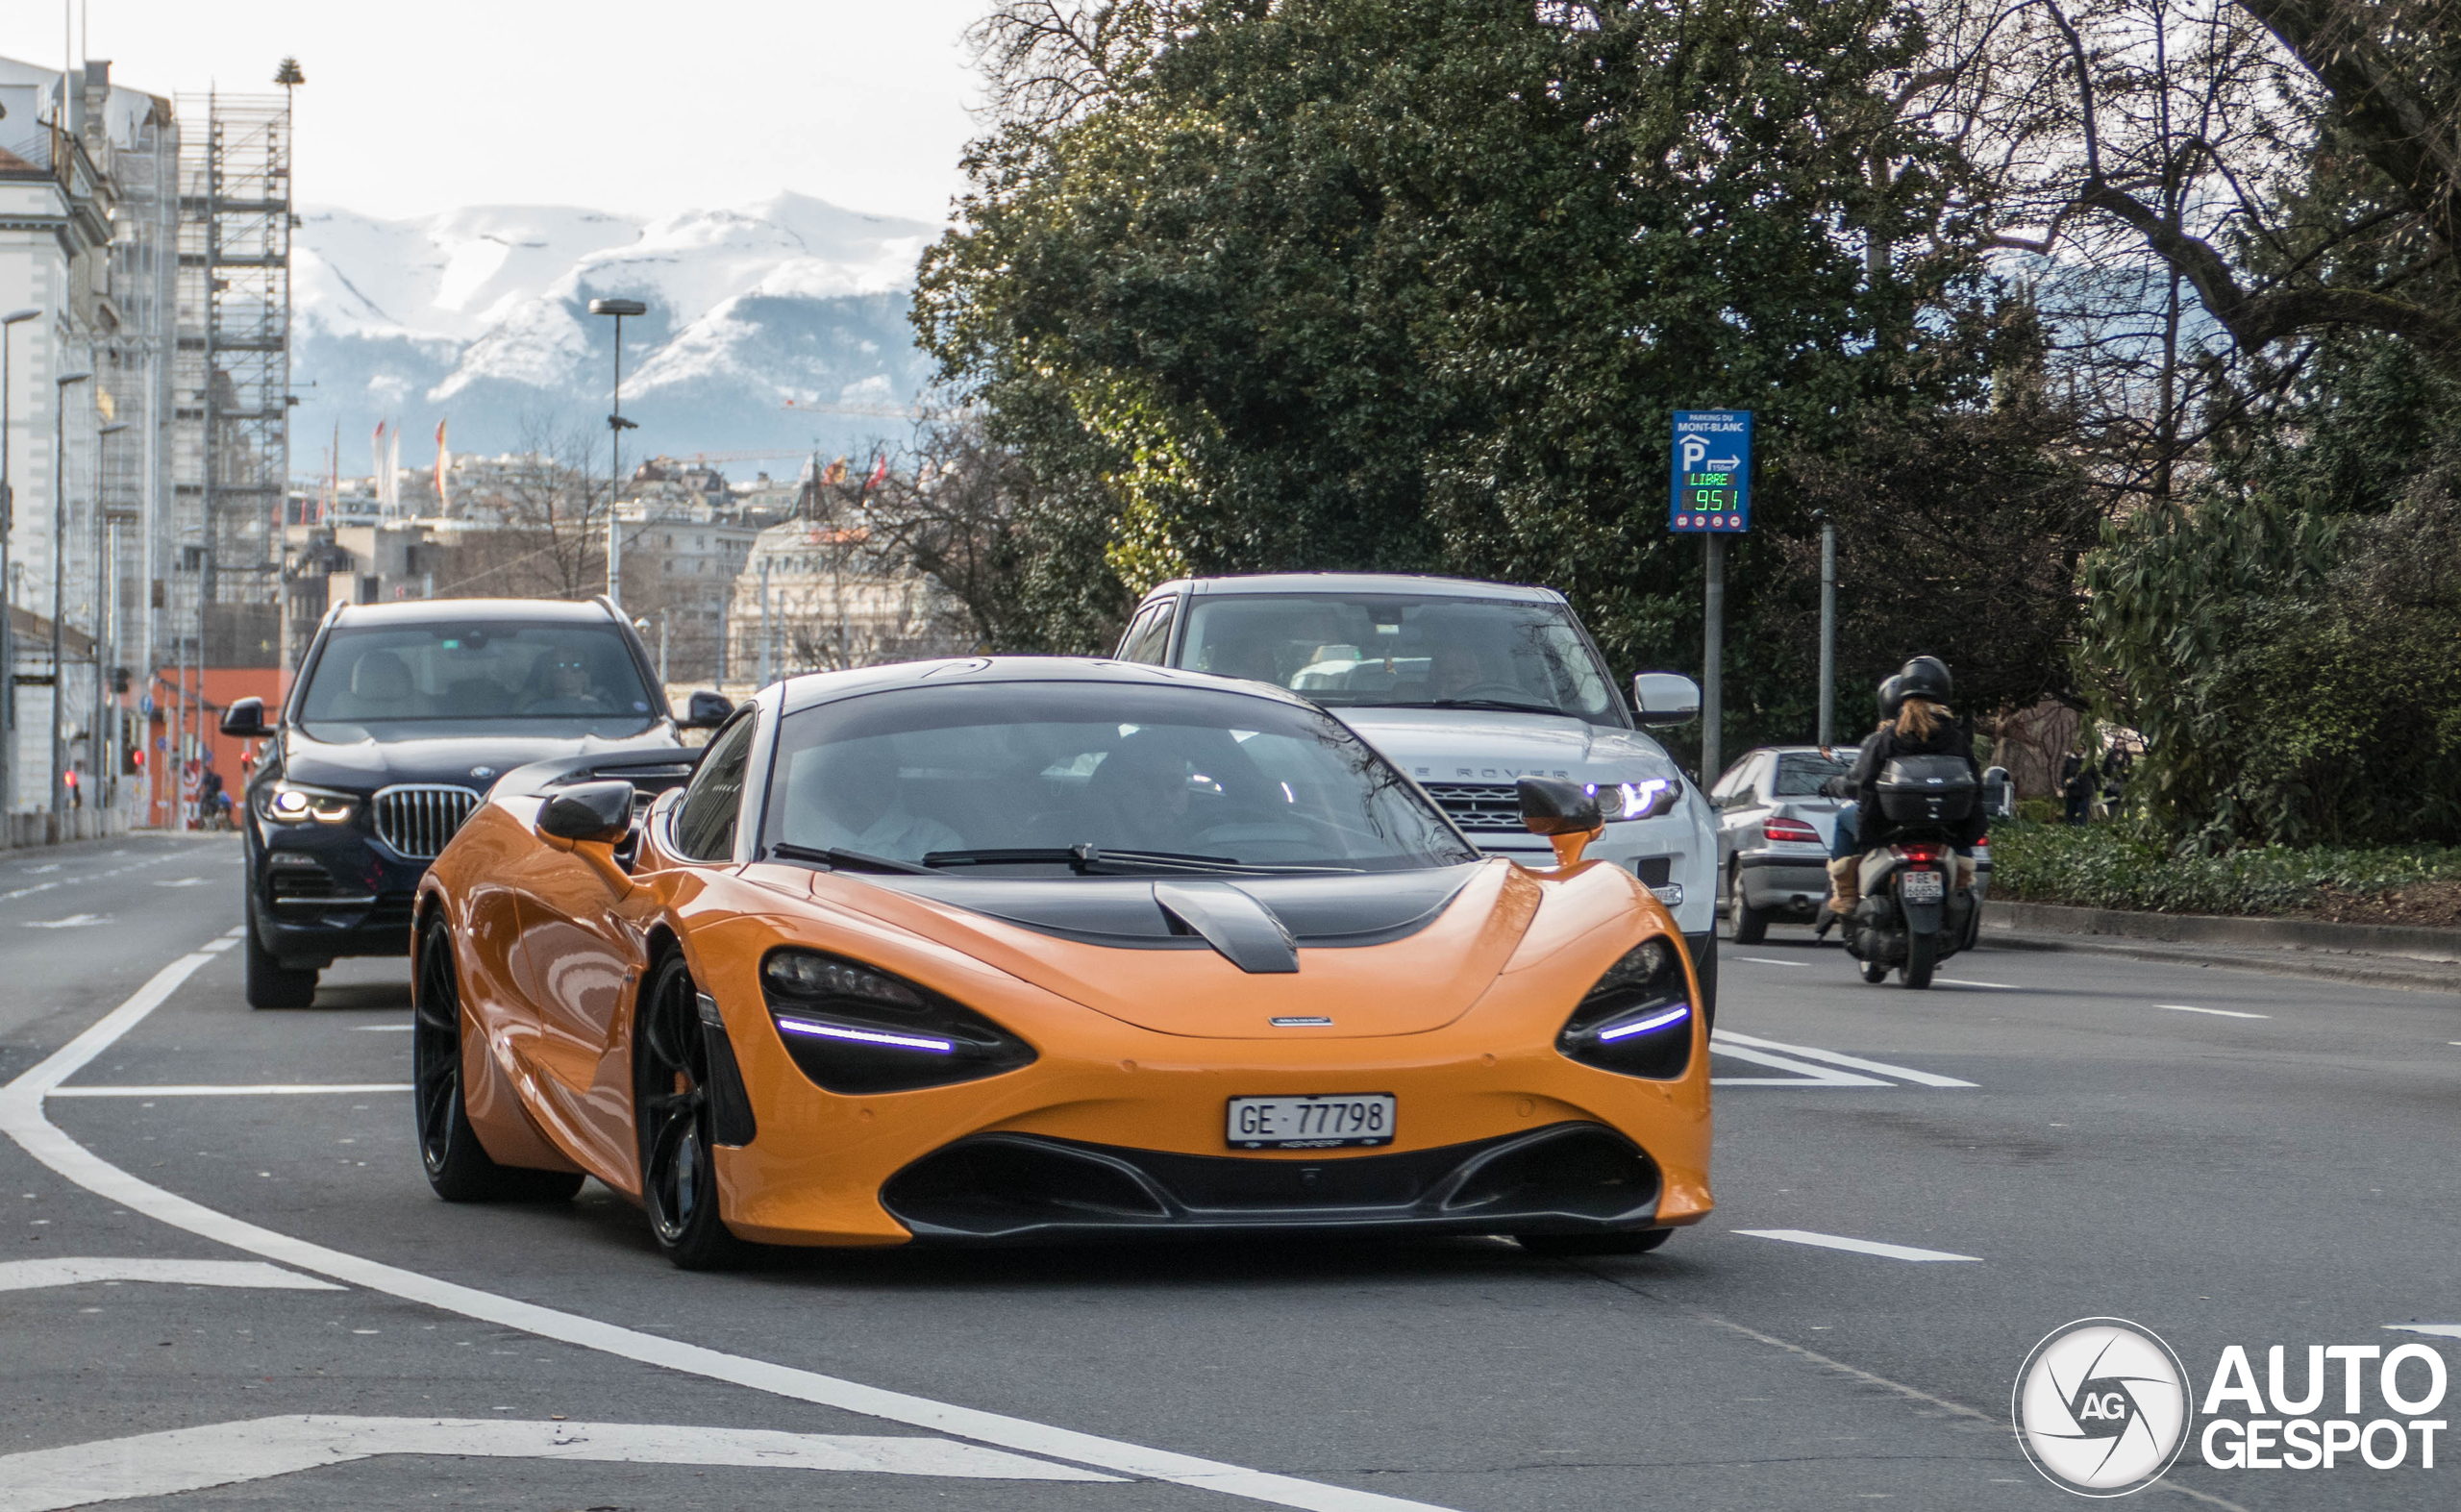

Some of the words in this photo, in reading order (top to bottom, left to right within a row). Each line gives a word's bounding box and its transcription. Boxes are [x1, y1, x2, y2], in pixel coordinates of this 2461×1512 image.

[1678, 422, 1744, 432] MONT-BLANC
[1683, 443, 1705, 471] P
[1690, 473, 1728, 485] LIBRE
[1695, 489, 1738, 510] 951
[1456, 768, 1569, 779] ROVER
[1917, 873, 1929, 883] GE
[1240, 1104, 1275, 1134] GE
[1298, 1103, 1383, 1133] 77798
